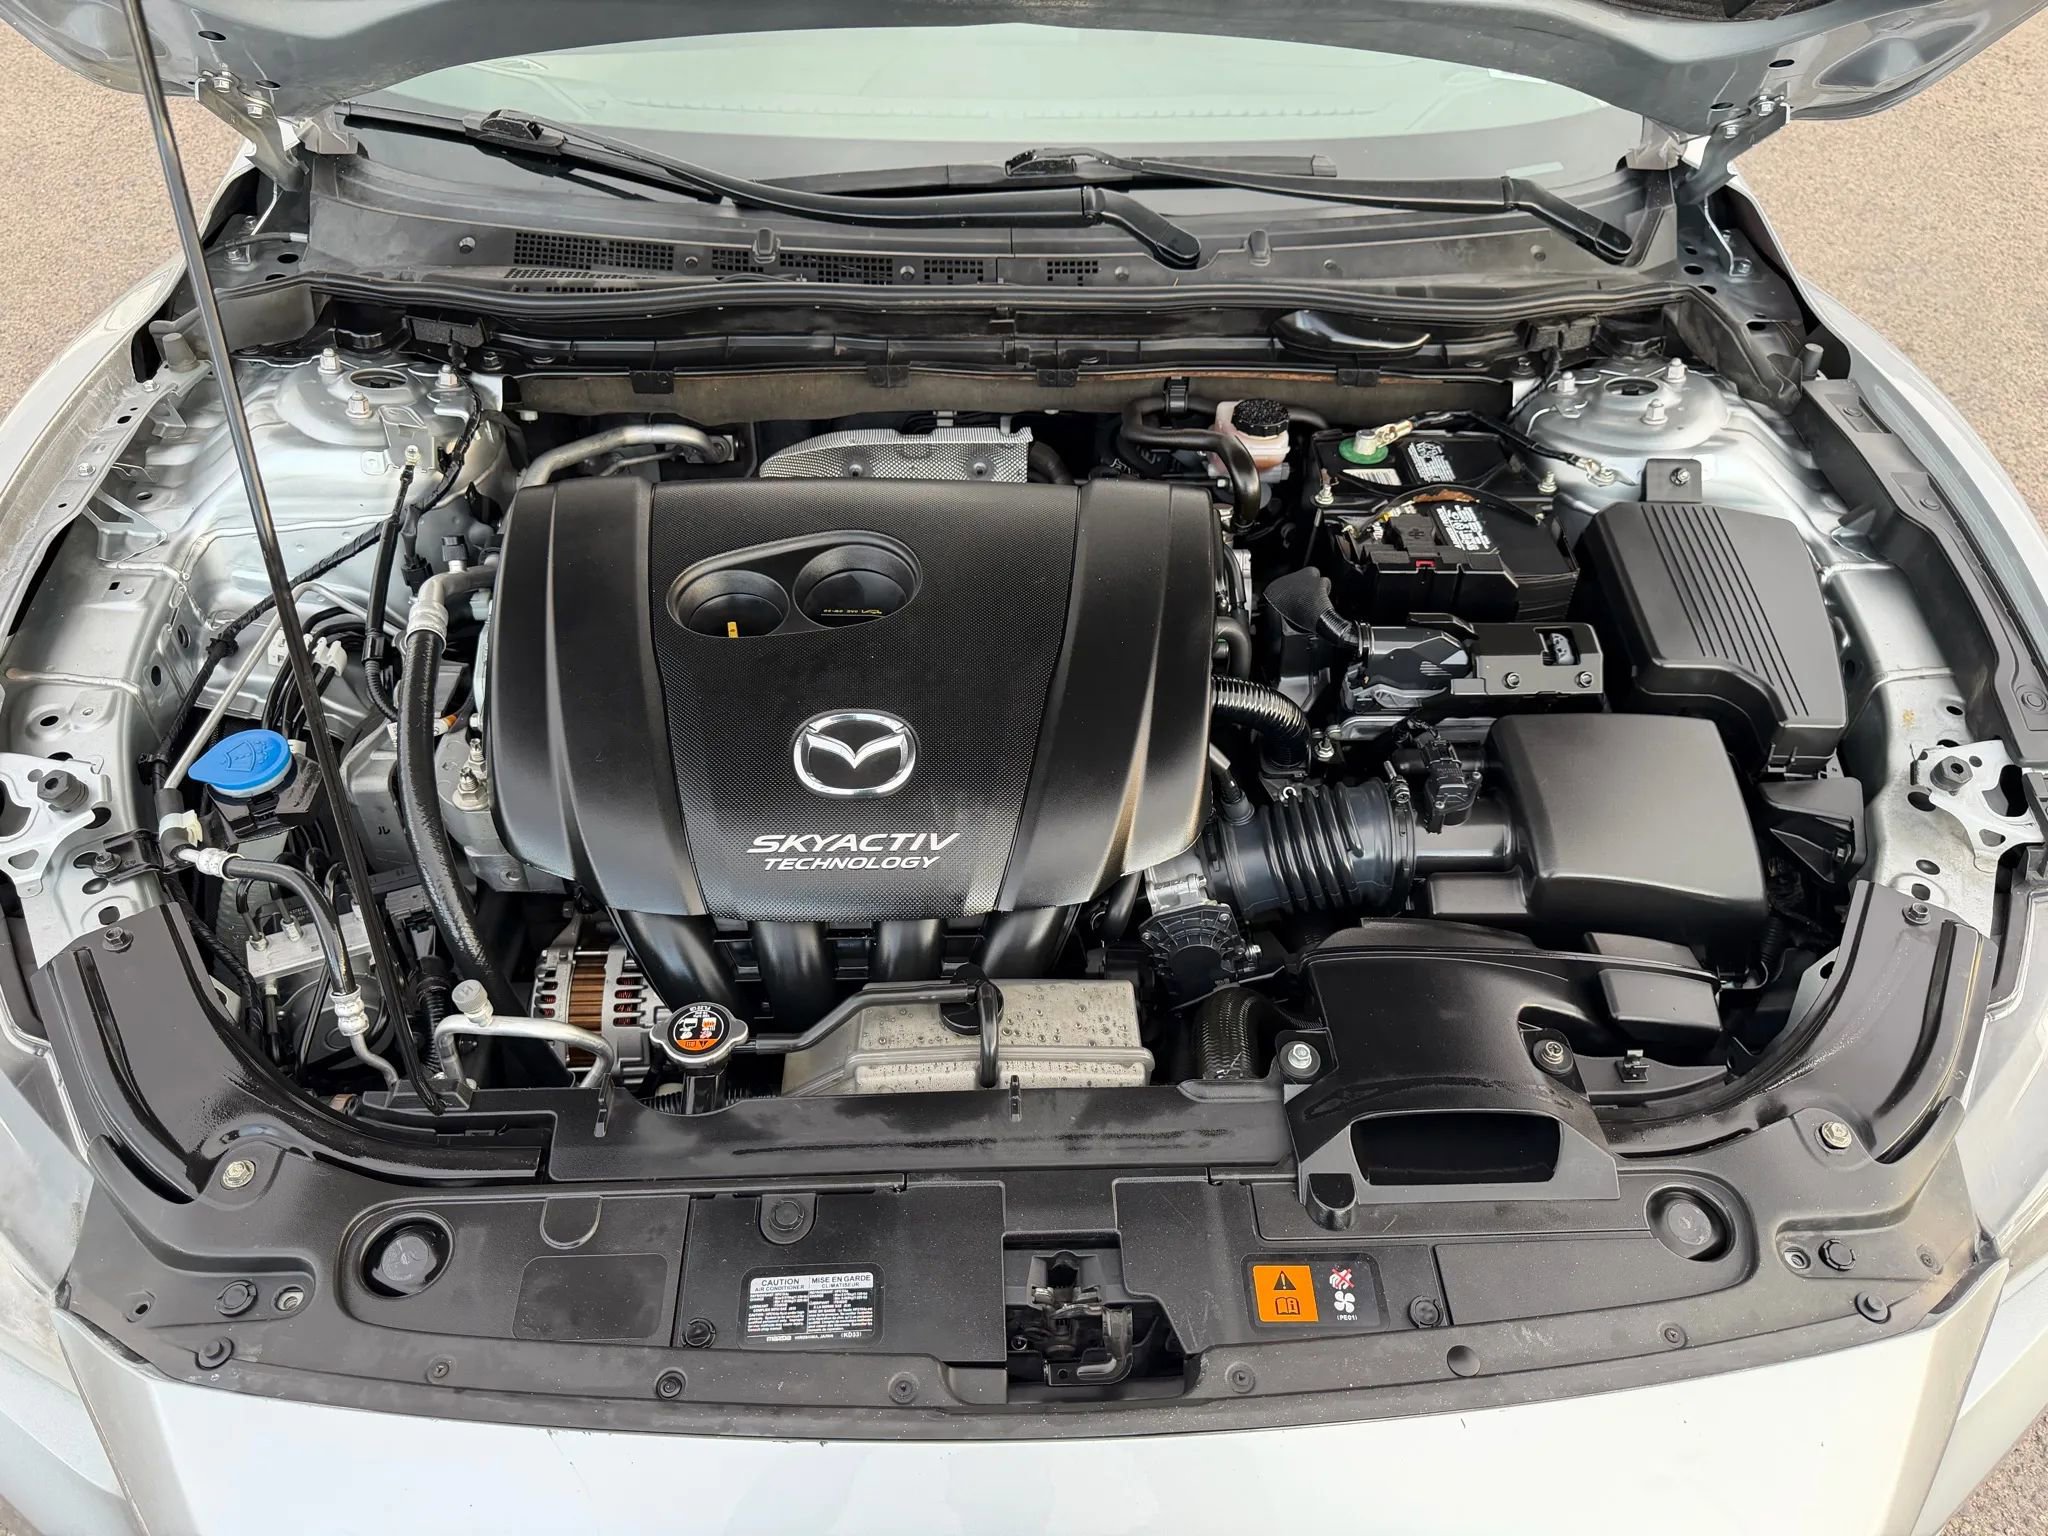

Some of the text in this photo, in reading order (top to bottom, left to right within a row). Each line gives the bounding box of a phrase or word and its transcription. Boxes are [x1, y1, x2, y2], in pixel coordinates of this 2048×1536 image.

[747, 832, 961, 853] SKYACTIV
[764, 856, 941, 871] TECHNOLOGY
[761, 1278, 800, 1287] CAUTION
[811, 1274, 871, 1284] MISE EN GARDE
